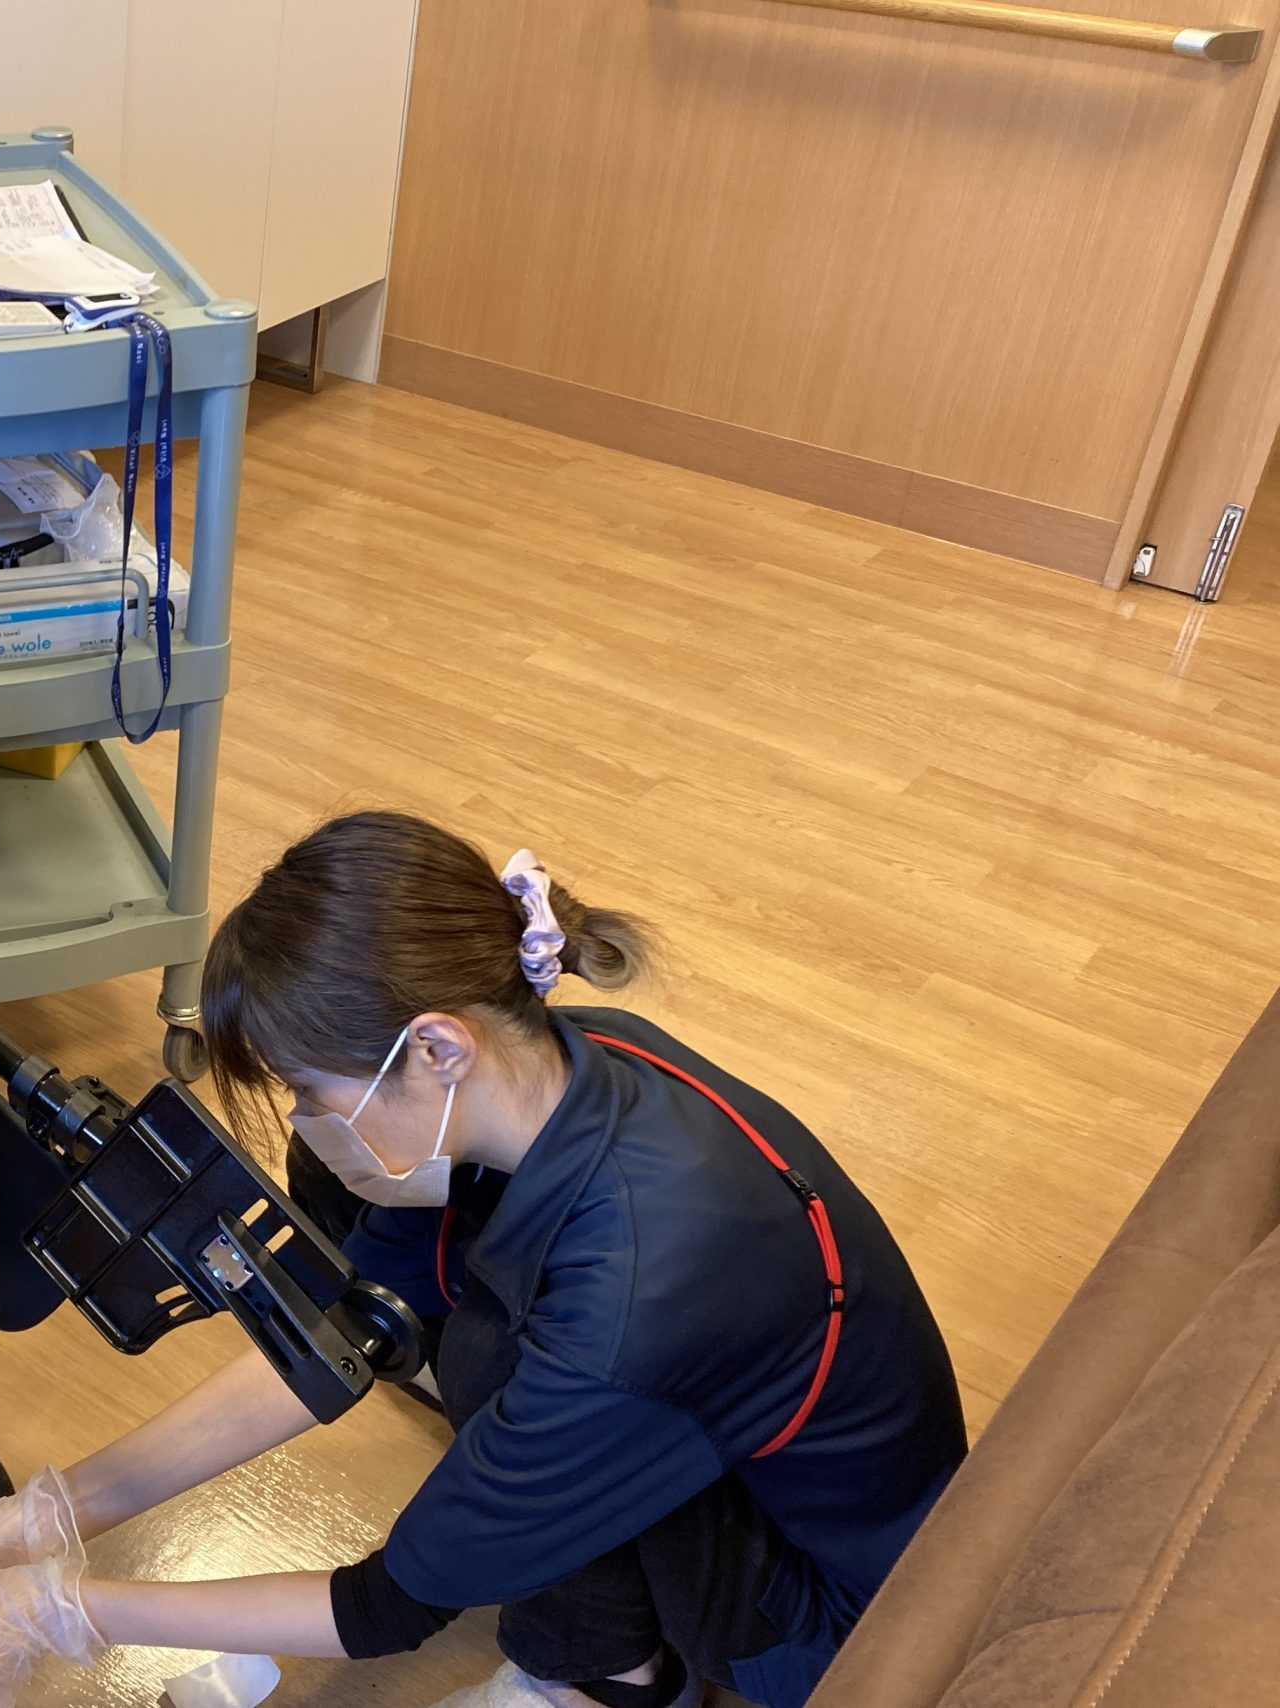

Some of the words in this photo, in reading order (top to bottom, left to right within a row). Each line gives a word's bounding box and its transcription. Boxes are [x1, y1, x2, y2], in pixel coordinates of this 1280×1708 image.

[160, 418, 168, 439] Navi
[128, 448, 136, 470] Vital
[159, 441, 168, 464] Vital
[3, 629, 21, 638] towel
[11, 634, 52, 653] wole
